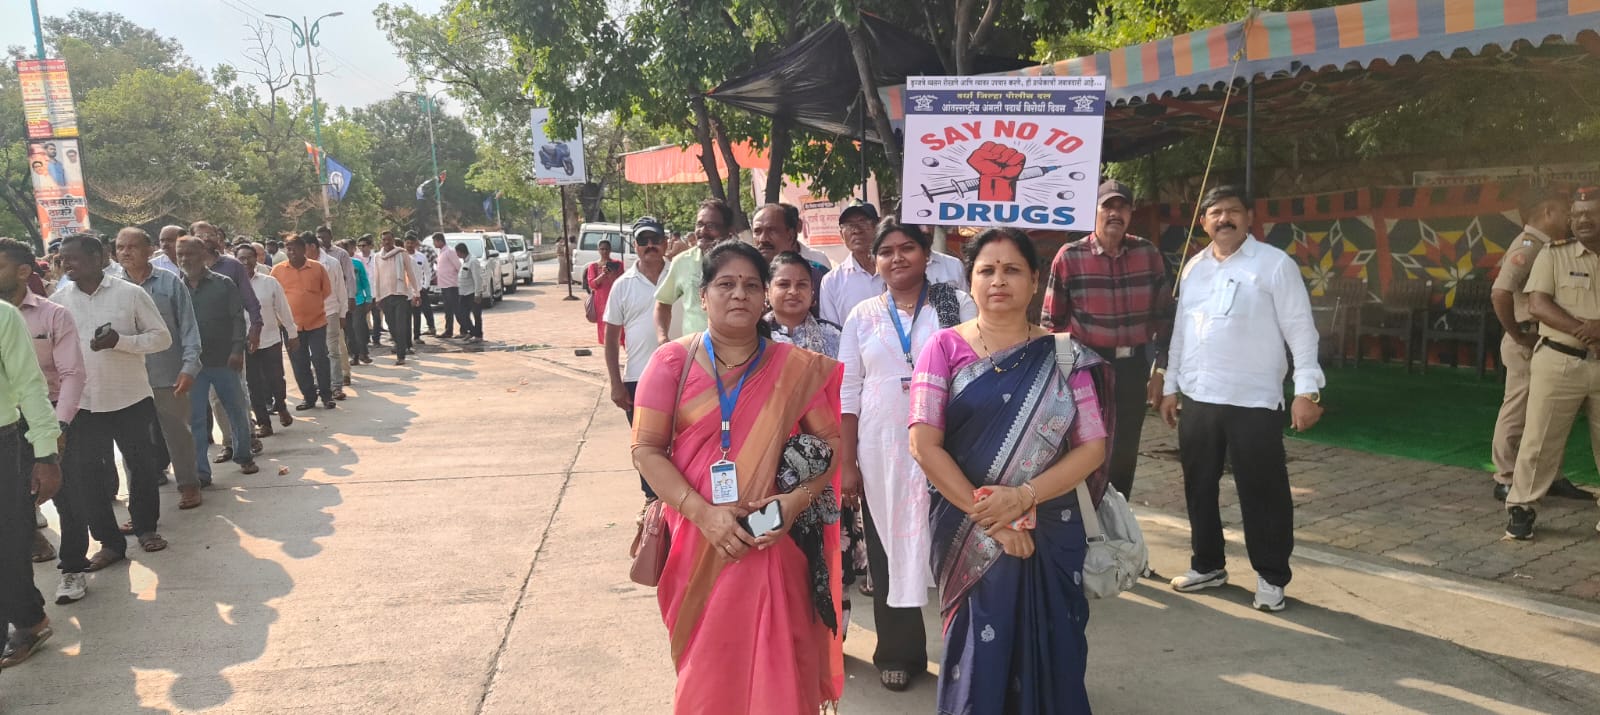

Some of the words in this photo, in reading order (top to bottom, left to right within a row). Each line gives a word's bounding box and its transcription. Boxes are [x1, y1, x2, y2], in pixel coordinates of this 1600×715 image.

[920, 121, 982, 151] SAY
[993, 119, 1039, 141] NO
[1043, 127, 1084, 154] TO
[938, 202, 1076, 225] DRUGS
